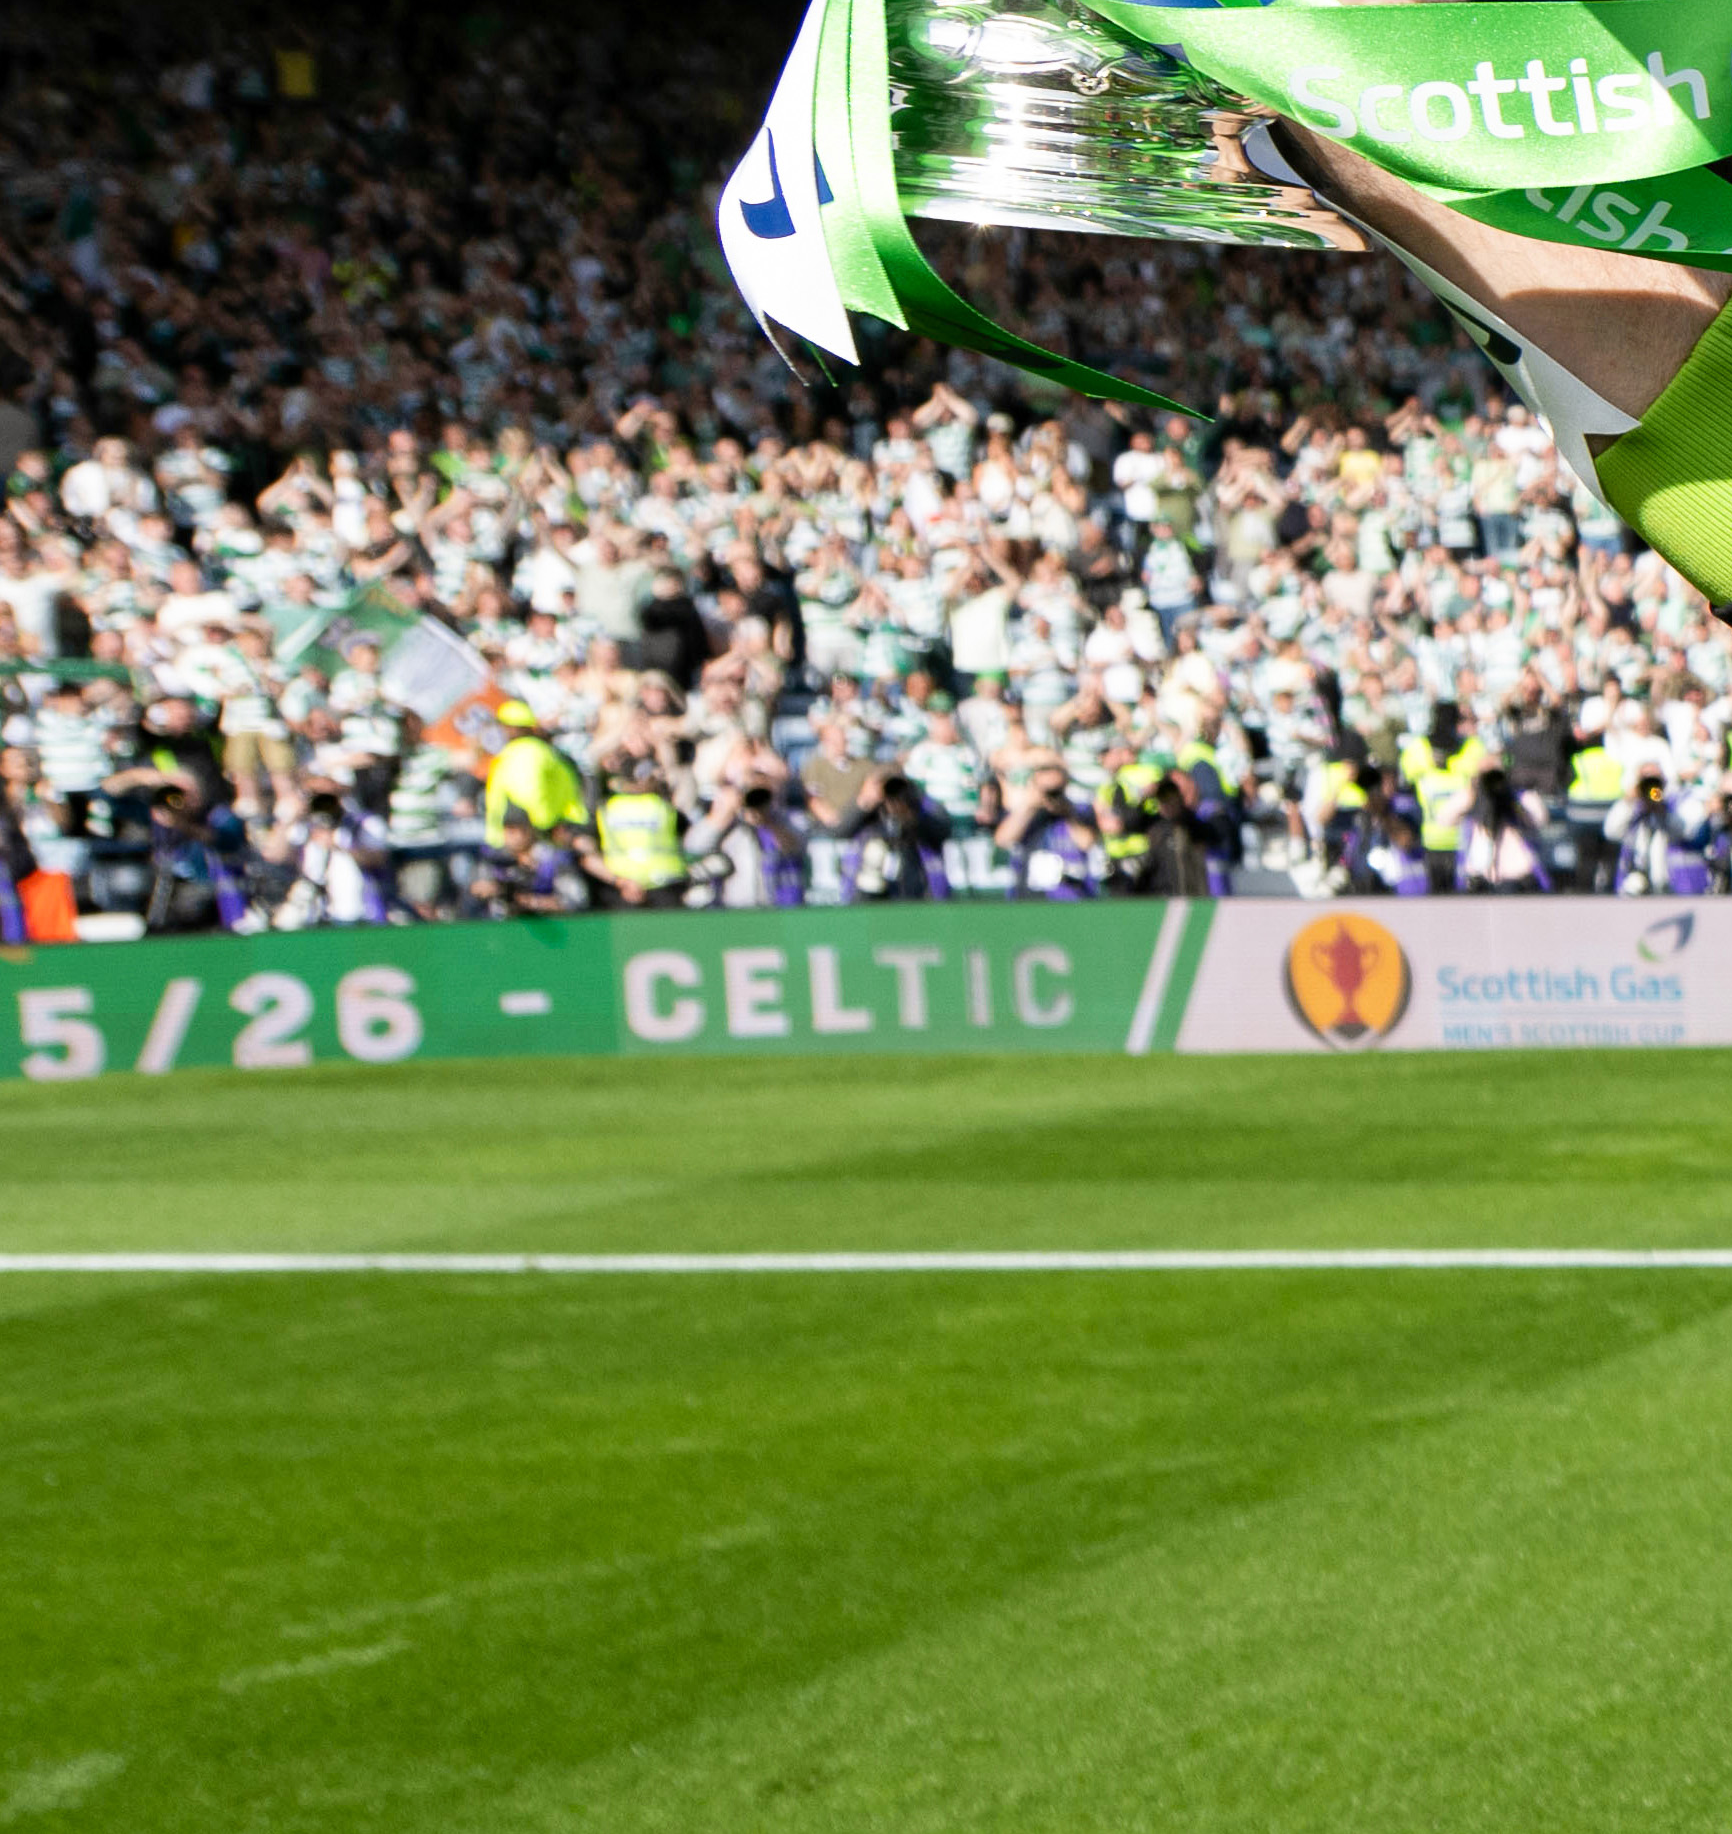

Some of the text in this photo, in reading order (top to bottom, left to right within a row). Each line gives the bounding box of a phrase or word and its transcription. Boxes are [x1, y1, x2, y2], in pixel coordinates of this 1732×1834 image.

[1286, 49, 1712, 144] Scottish
[622, 943, 1076, 1043] CELTIC
[1436, 965, 1684, 1005] Scottish Gas
[1520, 1021, 1632, 1044] SCOTTISH
[1639, 1021, 1688, 1044] CUP
